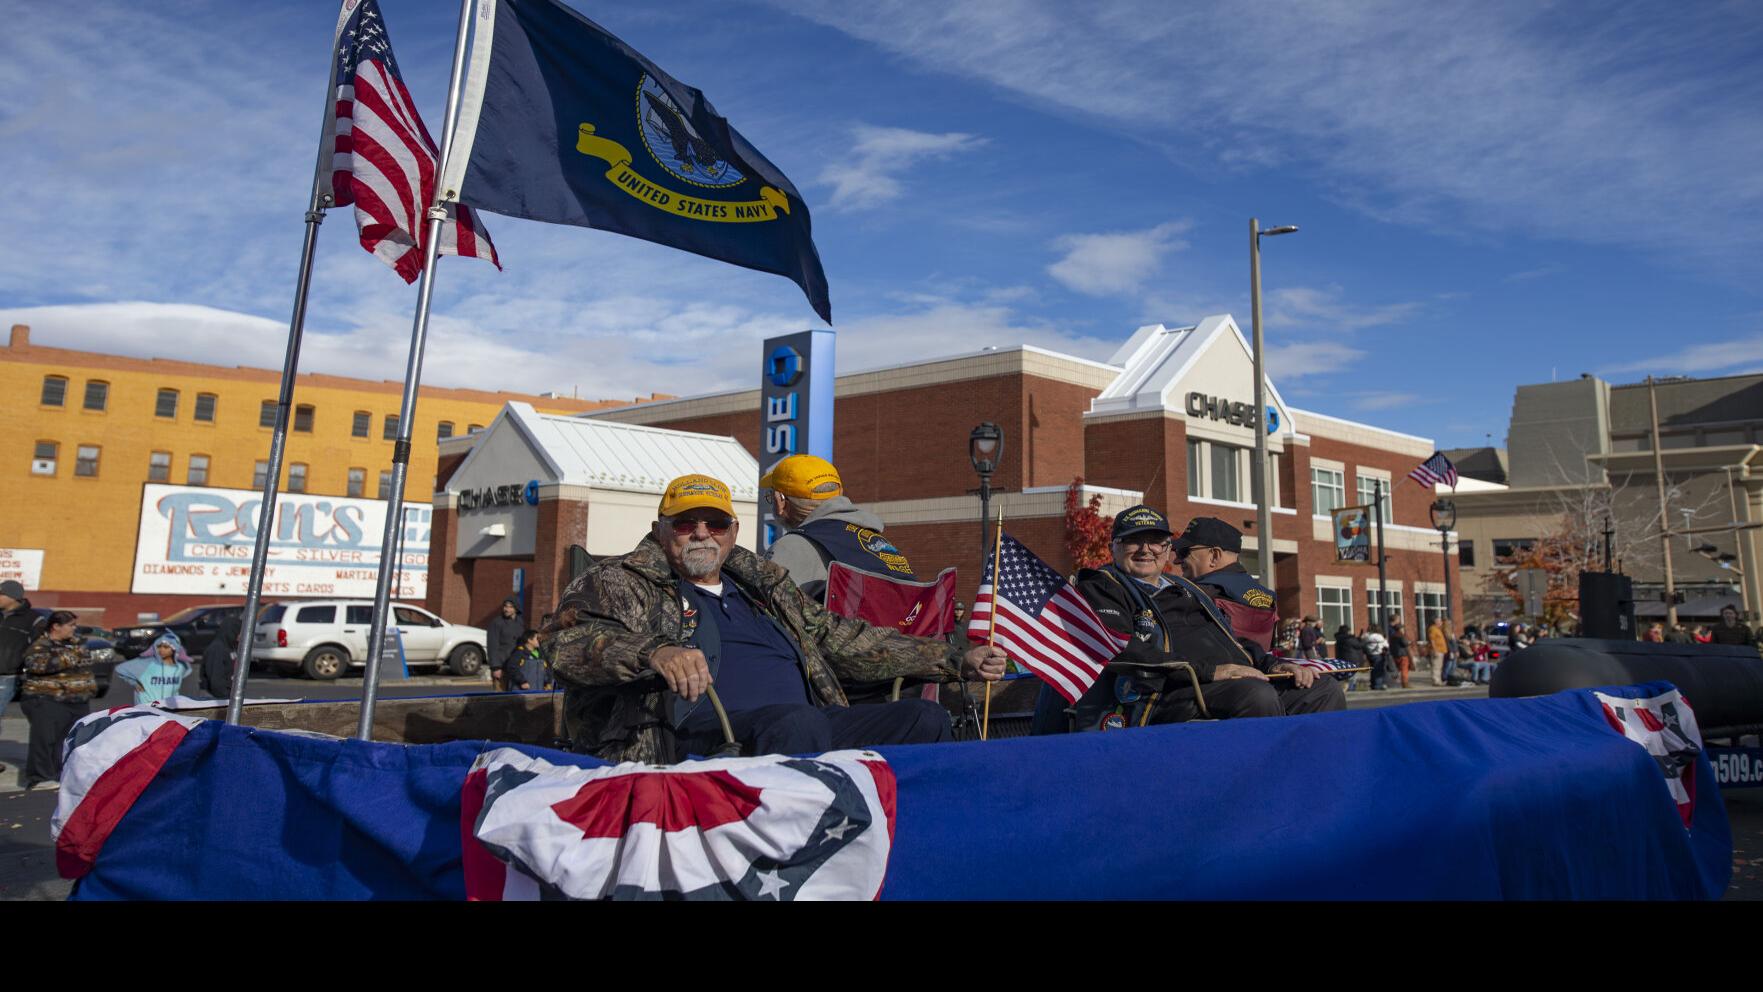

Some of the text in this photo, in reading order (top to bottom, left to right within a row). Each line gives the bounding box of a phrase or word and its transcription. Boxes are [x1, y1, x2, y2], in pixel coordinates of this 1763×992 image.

[617, 170, 769, 219] UNITED STATES NAVY
[1184, 392, 1255, 430] CHASE
[460, 484, 524, 510] CHASE
[157, 492, 364, 546] Ron's
[191, 544, 249, 557] COINS
[296, 549, 362, 562] SILVER
[143, 563, 204, 575] DIAMONDS
[296, 583, 335, 593] CARDS
